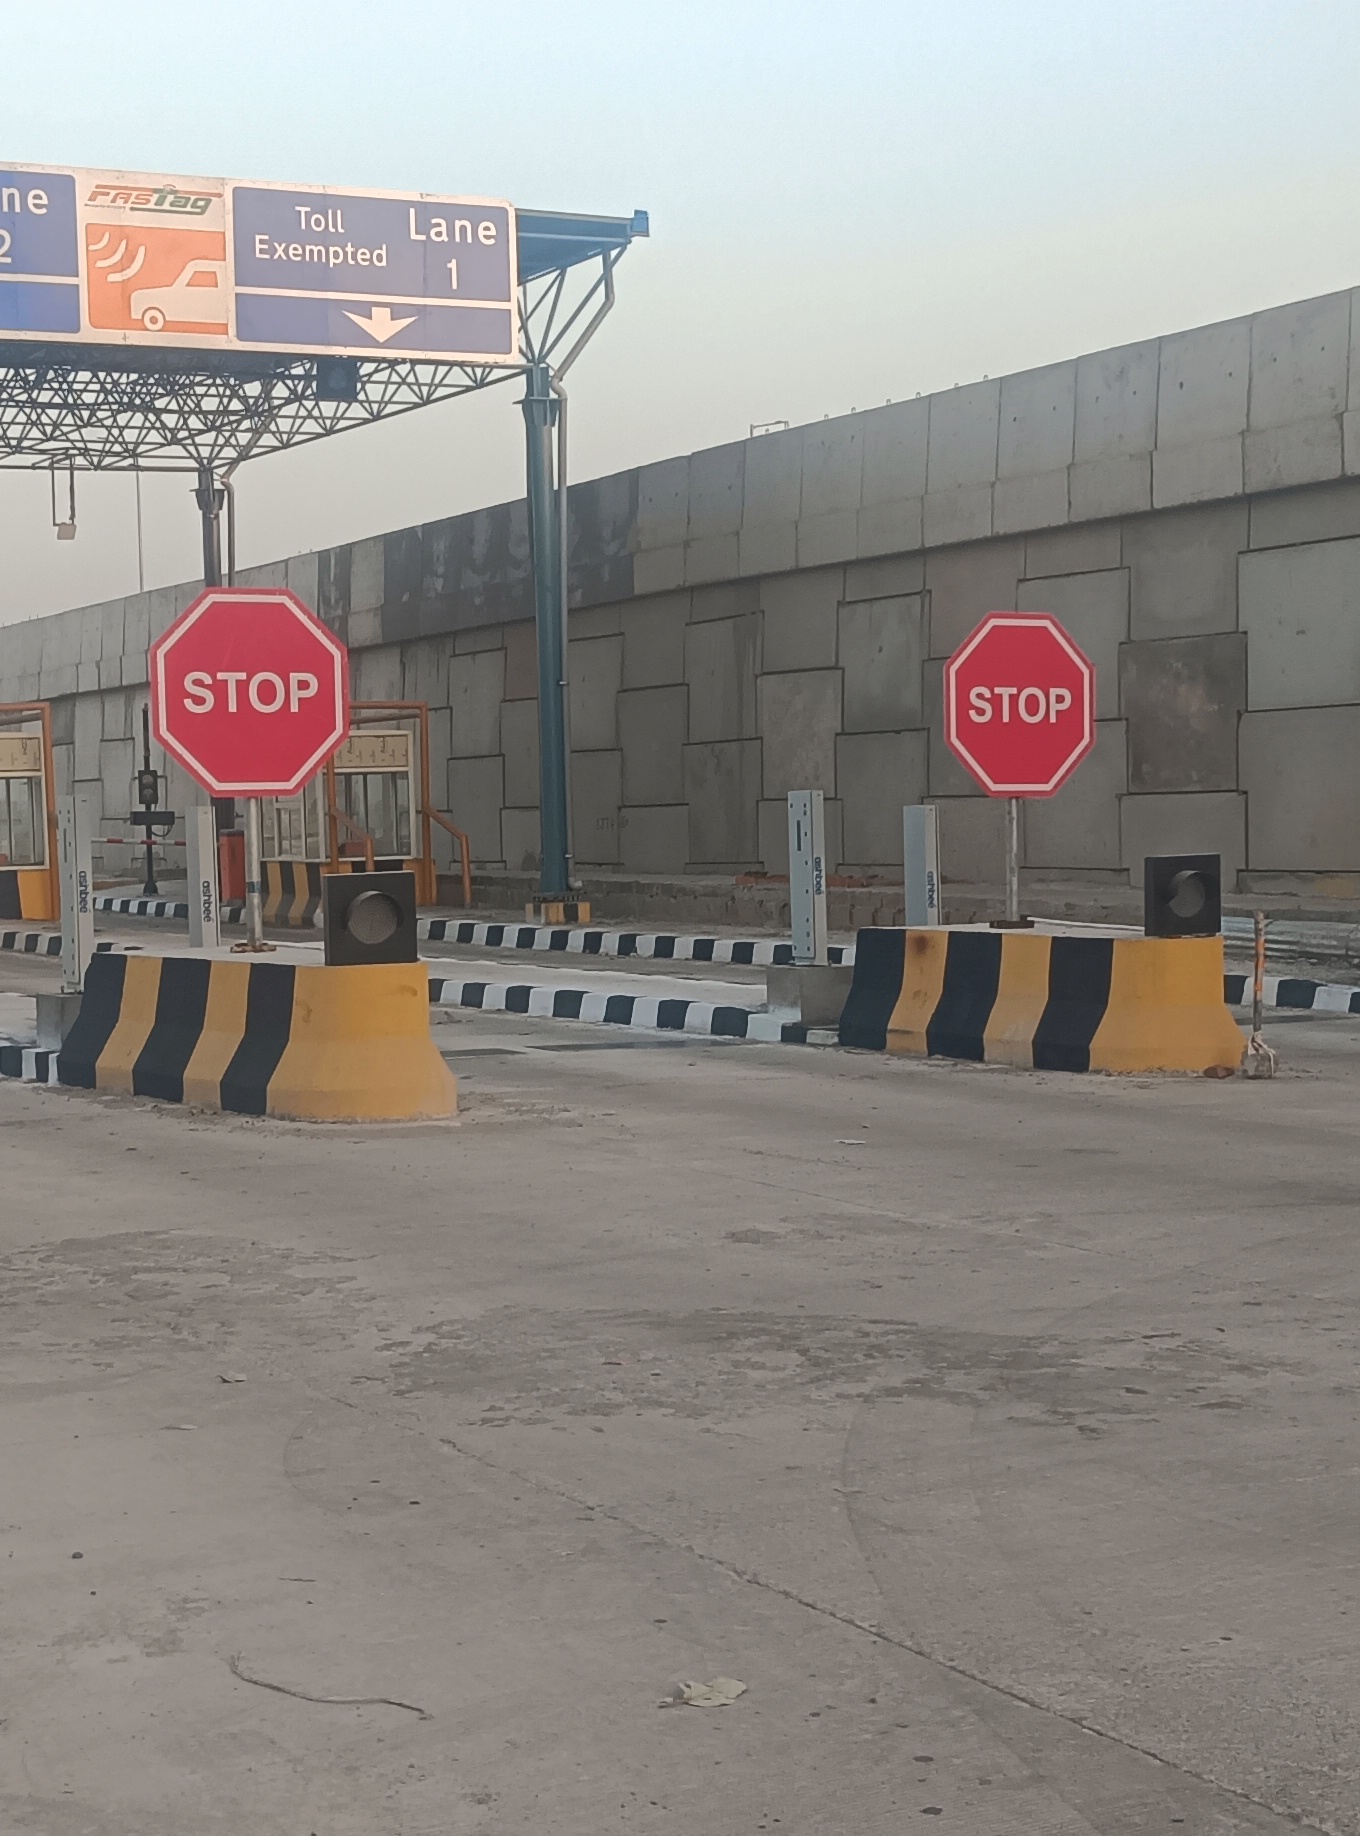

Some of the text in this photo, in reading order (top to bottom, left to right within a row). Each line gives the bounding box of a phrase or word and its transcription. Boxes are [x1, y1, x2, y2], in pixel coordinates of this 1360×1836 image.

[294, 206, 345, 233] Toll
[409, 207, 497, 245] Lane
[255, 234, 387, 268] Exempted
[446, 258, 458, 290] 1
[183, 671, 319, 714] STOP
[968, 686, 1072, 724] STOP
